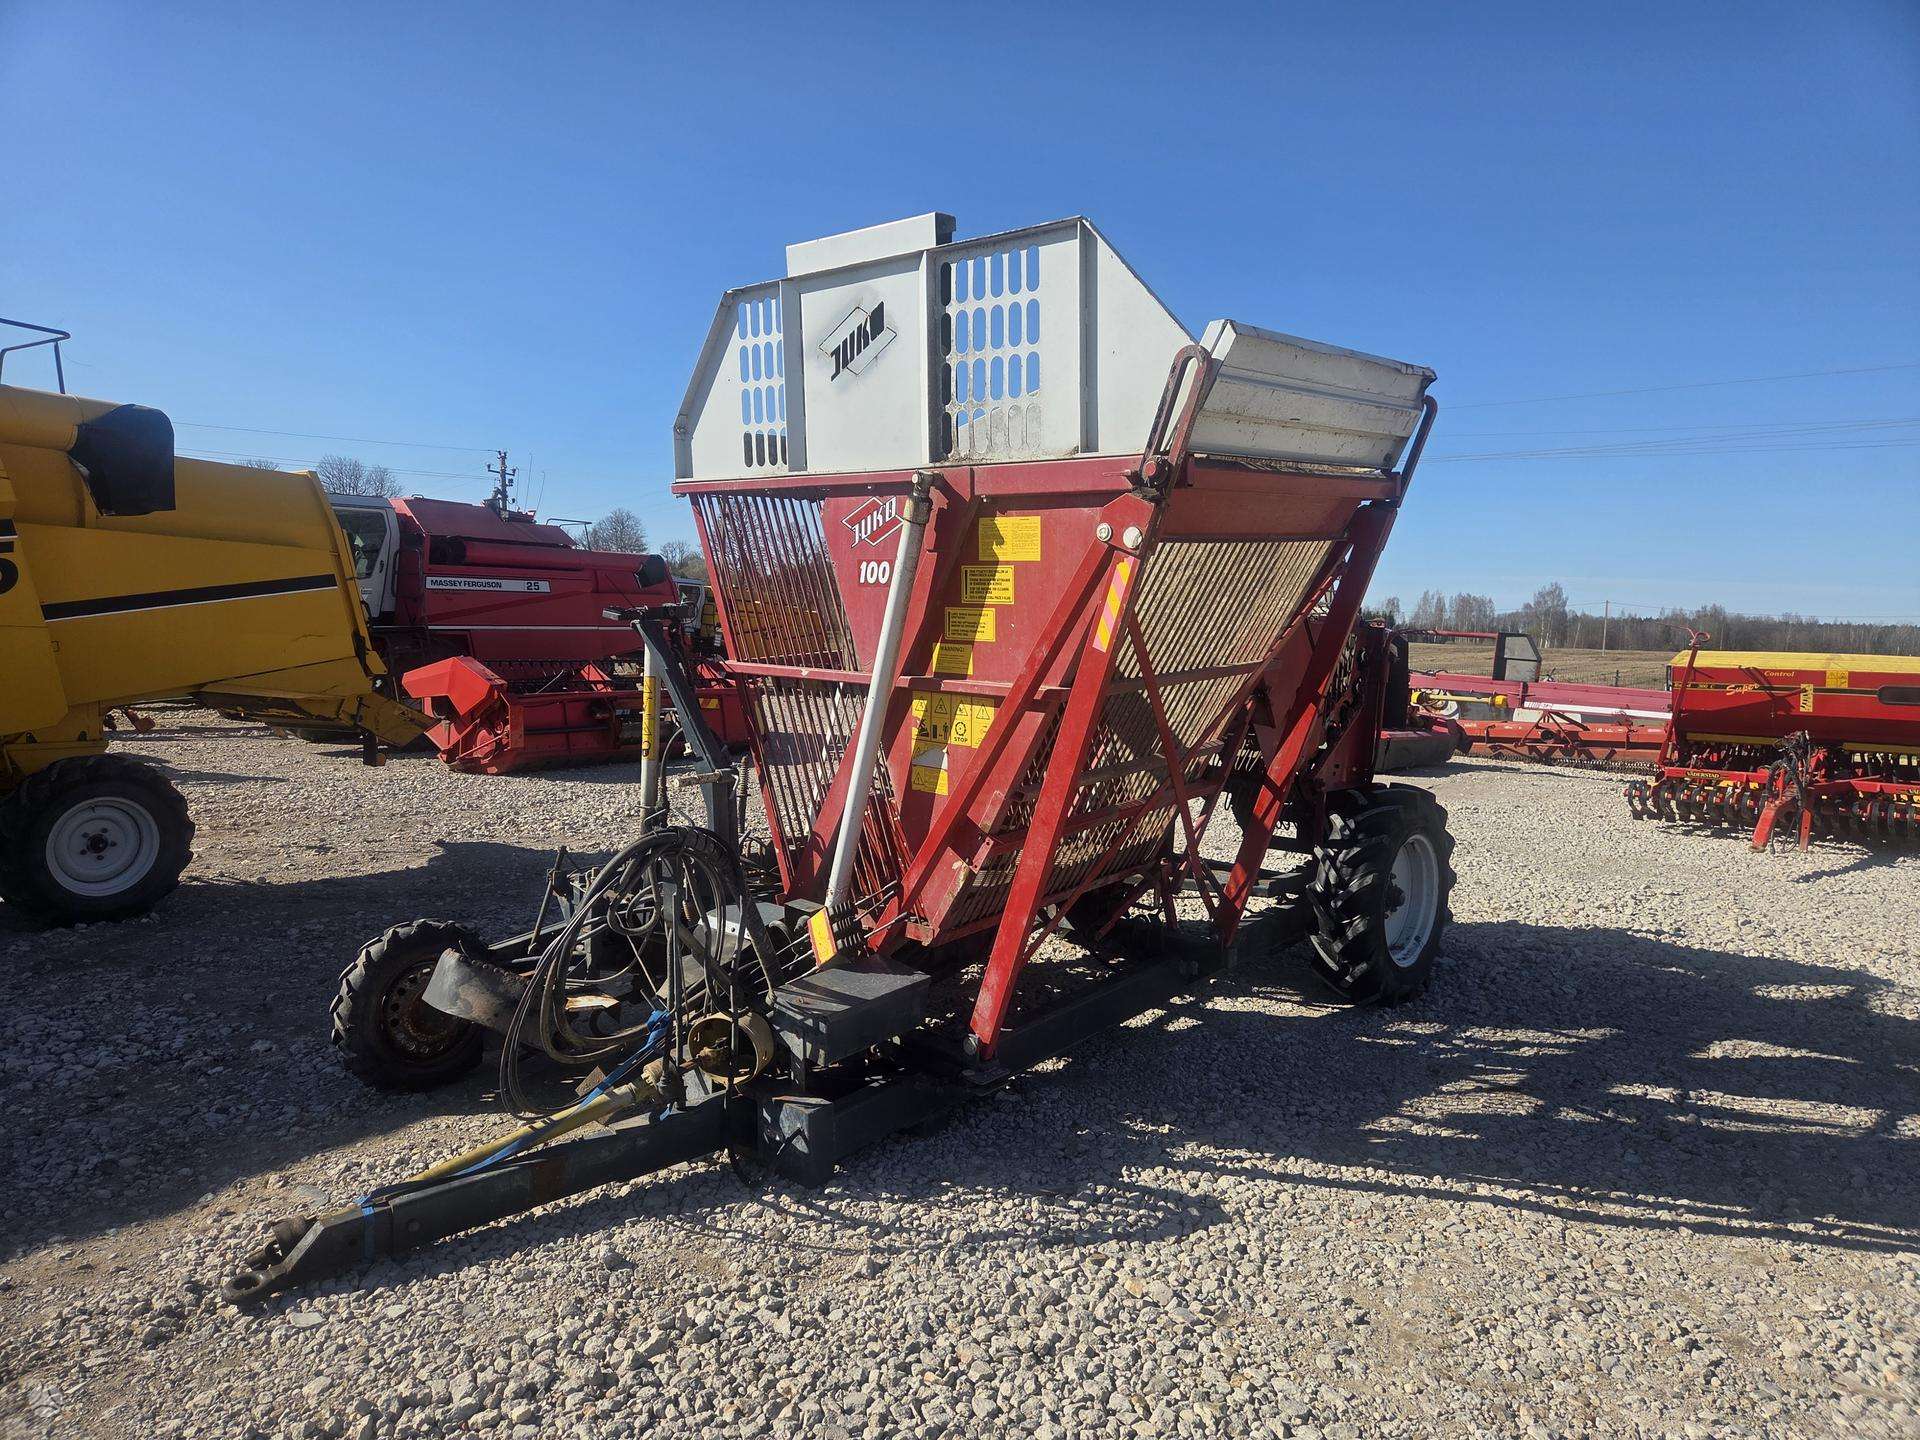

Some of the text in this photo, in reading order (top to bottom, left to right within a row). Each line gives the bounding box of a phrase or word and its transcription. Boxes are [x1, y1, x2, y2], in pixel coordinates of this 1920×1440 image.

[851, 495, 897, 548] JUKO
[859, 560, 890, 584] 100
[430, 578, 540, 591] MASSEY FERGUSON 25
[1763, 669, 1796, 678] Control
